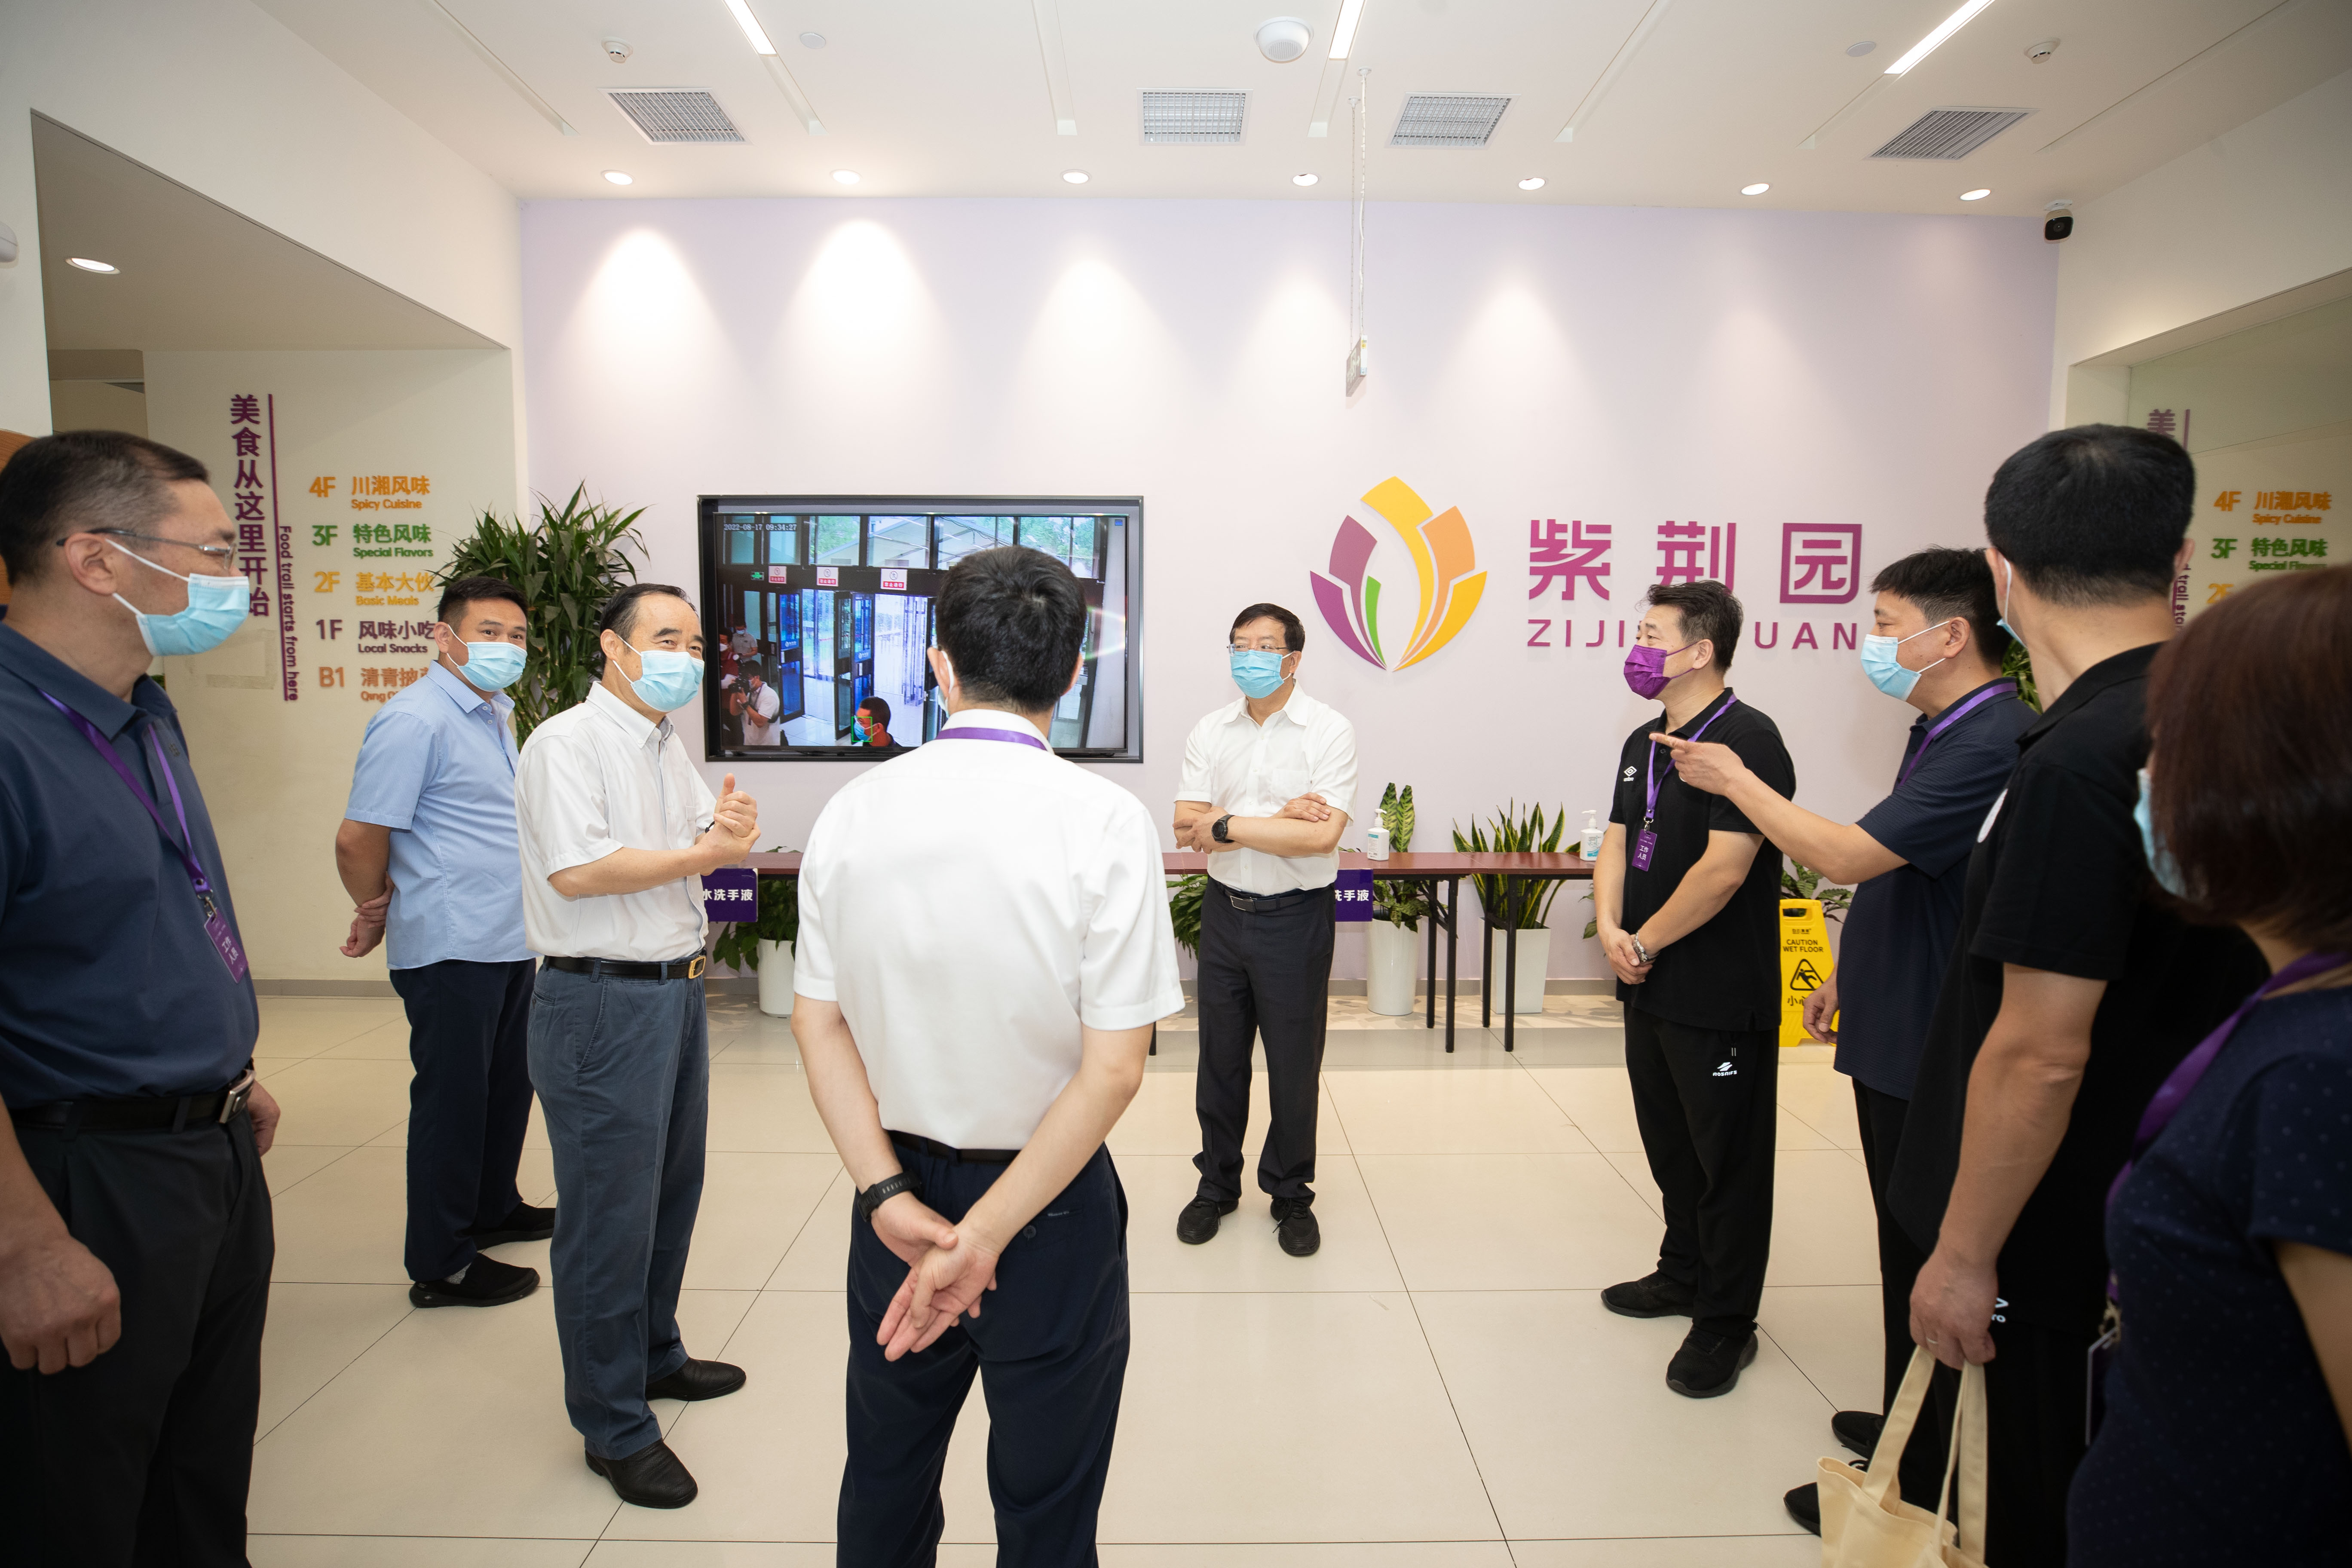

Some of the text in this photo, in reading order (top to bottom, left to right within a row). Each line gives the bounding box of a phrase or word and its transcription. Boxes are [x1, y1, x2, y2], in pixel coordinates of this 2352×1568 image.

[309, 475, 430, 498] 4F 川湘风味
[230, 394, 270, 617] 美食从这里开始
[351, 499, 423, 511] Spicy Cuisine
[2214, 491, 2242, 511] 4F
[279, 526, 293, 558] Food
[312, 523, 432, 546] 3F 特色风味
[353, 547, 433, 559] Special Flavors
[2211, 537, 2328, 559] 3F 特色风味
[1529, 519, 1862, 604] 紫荆园
[314, 571, 435, 592] 2F 基本大伙
[355, 595, 420, 606] Basic Meals
[283, 593, 296, 632] starts
[315, 619, 436, 640] 1F 风味小吃
[285, 636, 298, 667] from
[358, 643, 428, 653] Local Snacks
[287, 671, 300, 701] here
[319, 666, 429, 688] B1 清青披
